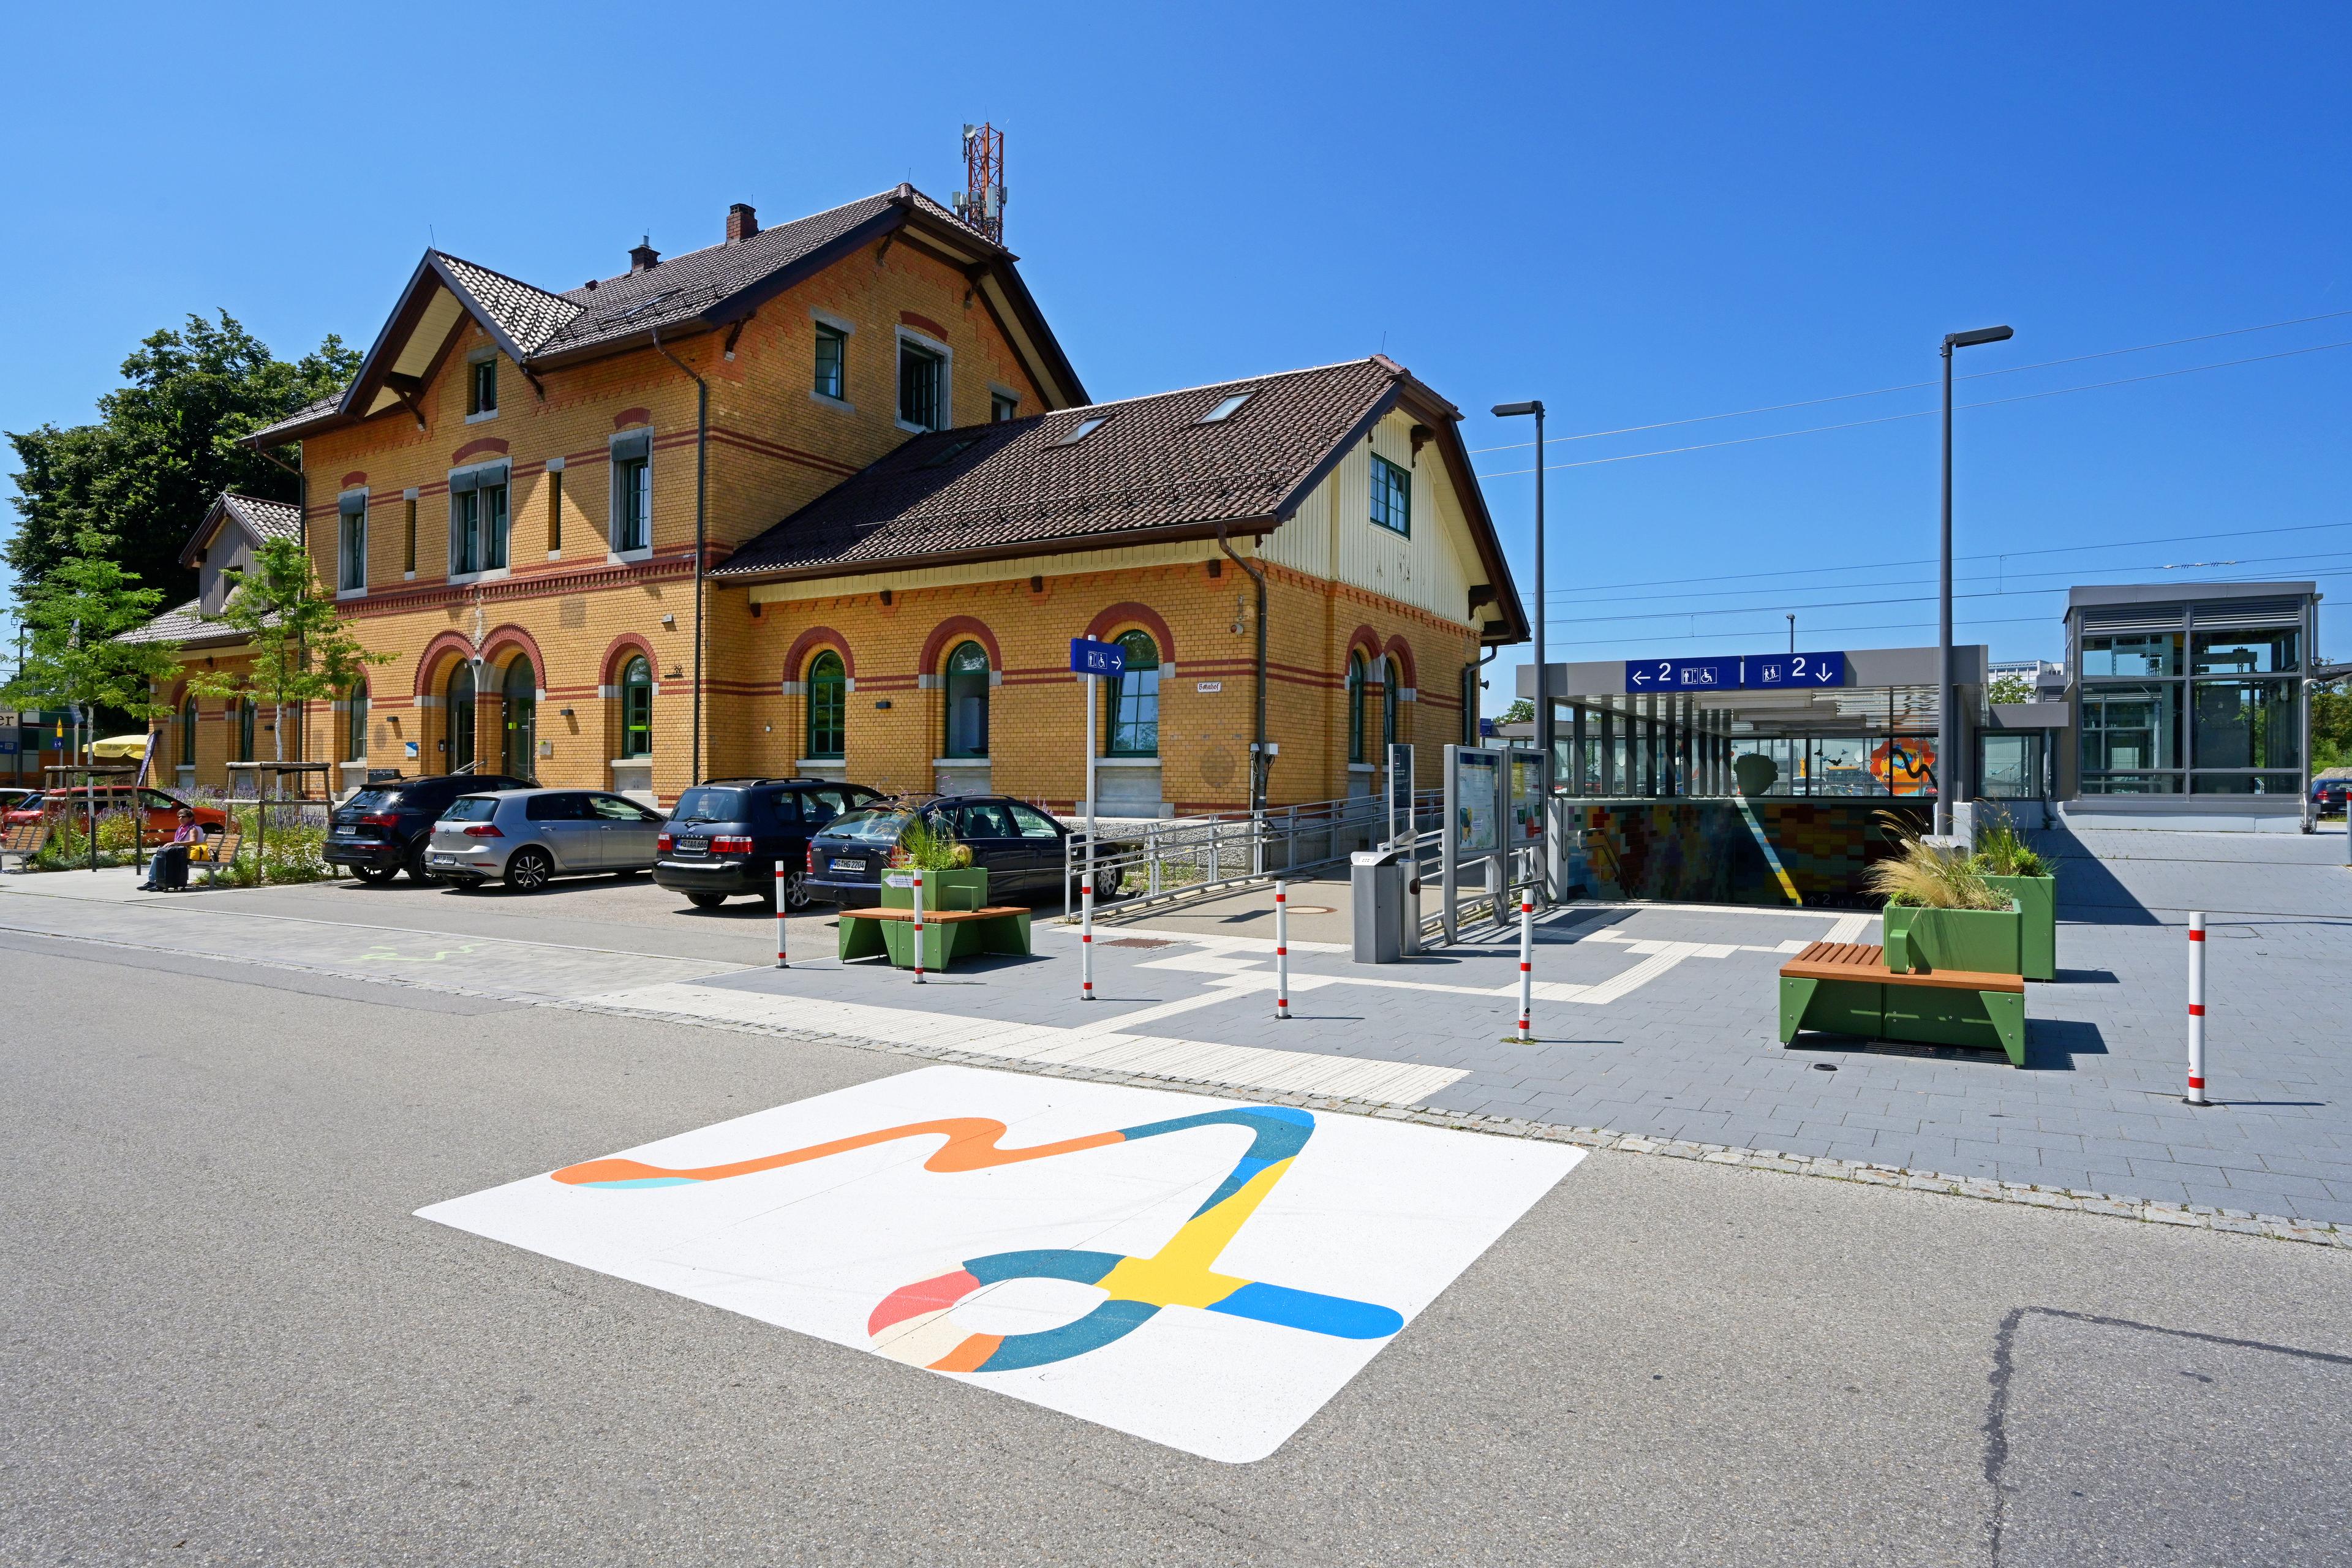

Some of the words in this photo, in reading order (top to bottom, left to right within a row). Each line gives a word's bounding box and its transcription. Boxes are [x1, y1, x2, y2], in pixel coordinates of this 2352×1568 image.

[1659, 662, 1672, 681] 2
[1792, 657, 1806, 677] 2
[851, 861, 864, 869] 2204
[1822, 894, 1831, 905] 2
